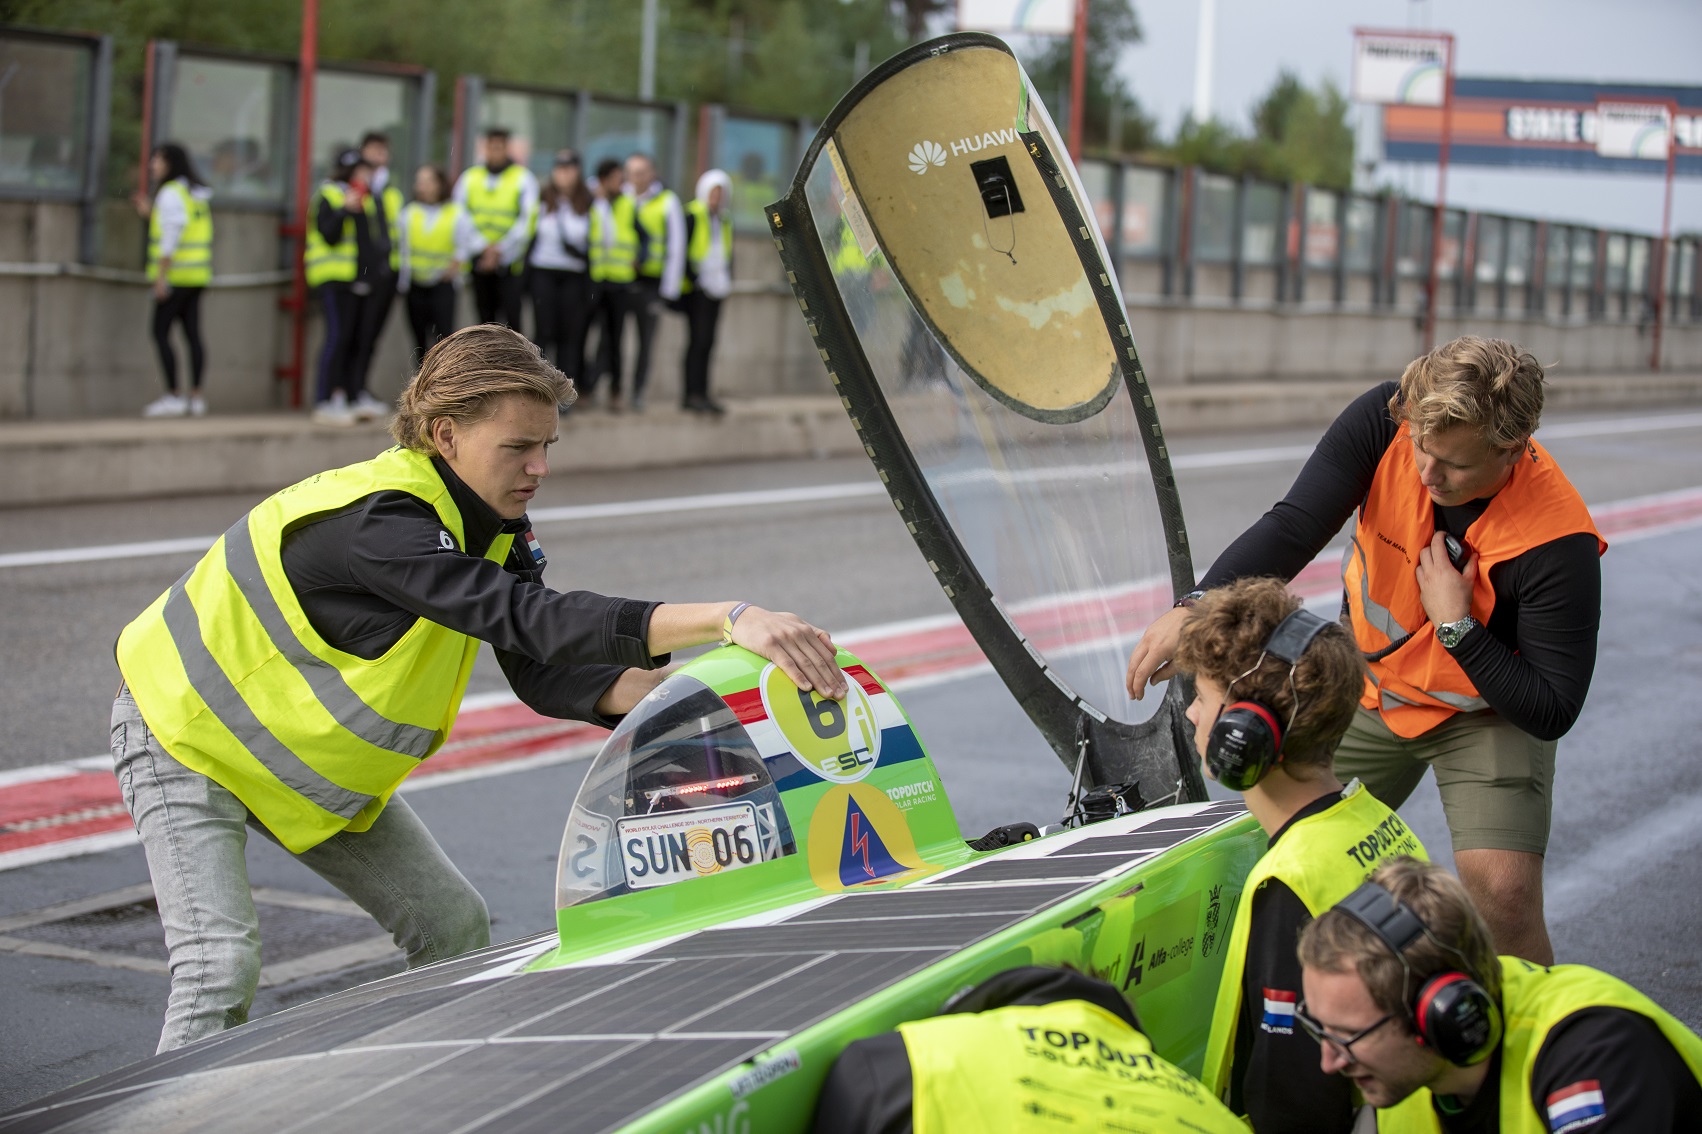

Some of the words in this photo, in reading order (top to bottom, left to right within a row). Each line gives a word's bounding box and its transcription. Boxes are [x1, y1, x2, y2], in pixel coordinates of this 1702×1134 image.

[1507, 107, 1579, 143] STATE
[1377, 532, 1393, 545] TEAM
[797, 686, 846, 739] 6
[820, 747, 873, 775] ESC
[886, 780, 934, 800] TOPDUTCH
[912, 794, 937, 806] RACING
[657, 821, 684, 830] CHALLENGE
[697, 816, 723, 825] NORTHERN
[722, 813, 749, 822] TERRITORY
[626, 832, 692, 877] SUN
[712, 824, 754, 867] 06
[1346, 812, 1407, 868] TOPDUTCH
[1148, 936, 1195, 972] Alfa-college
